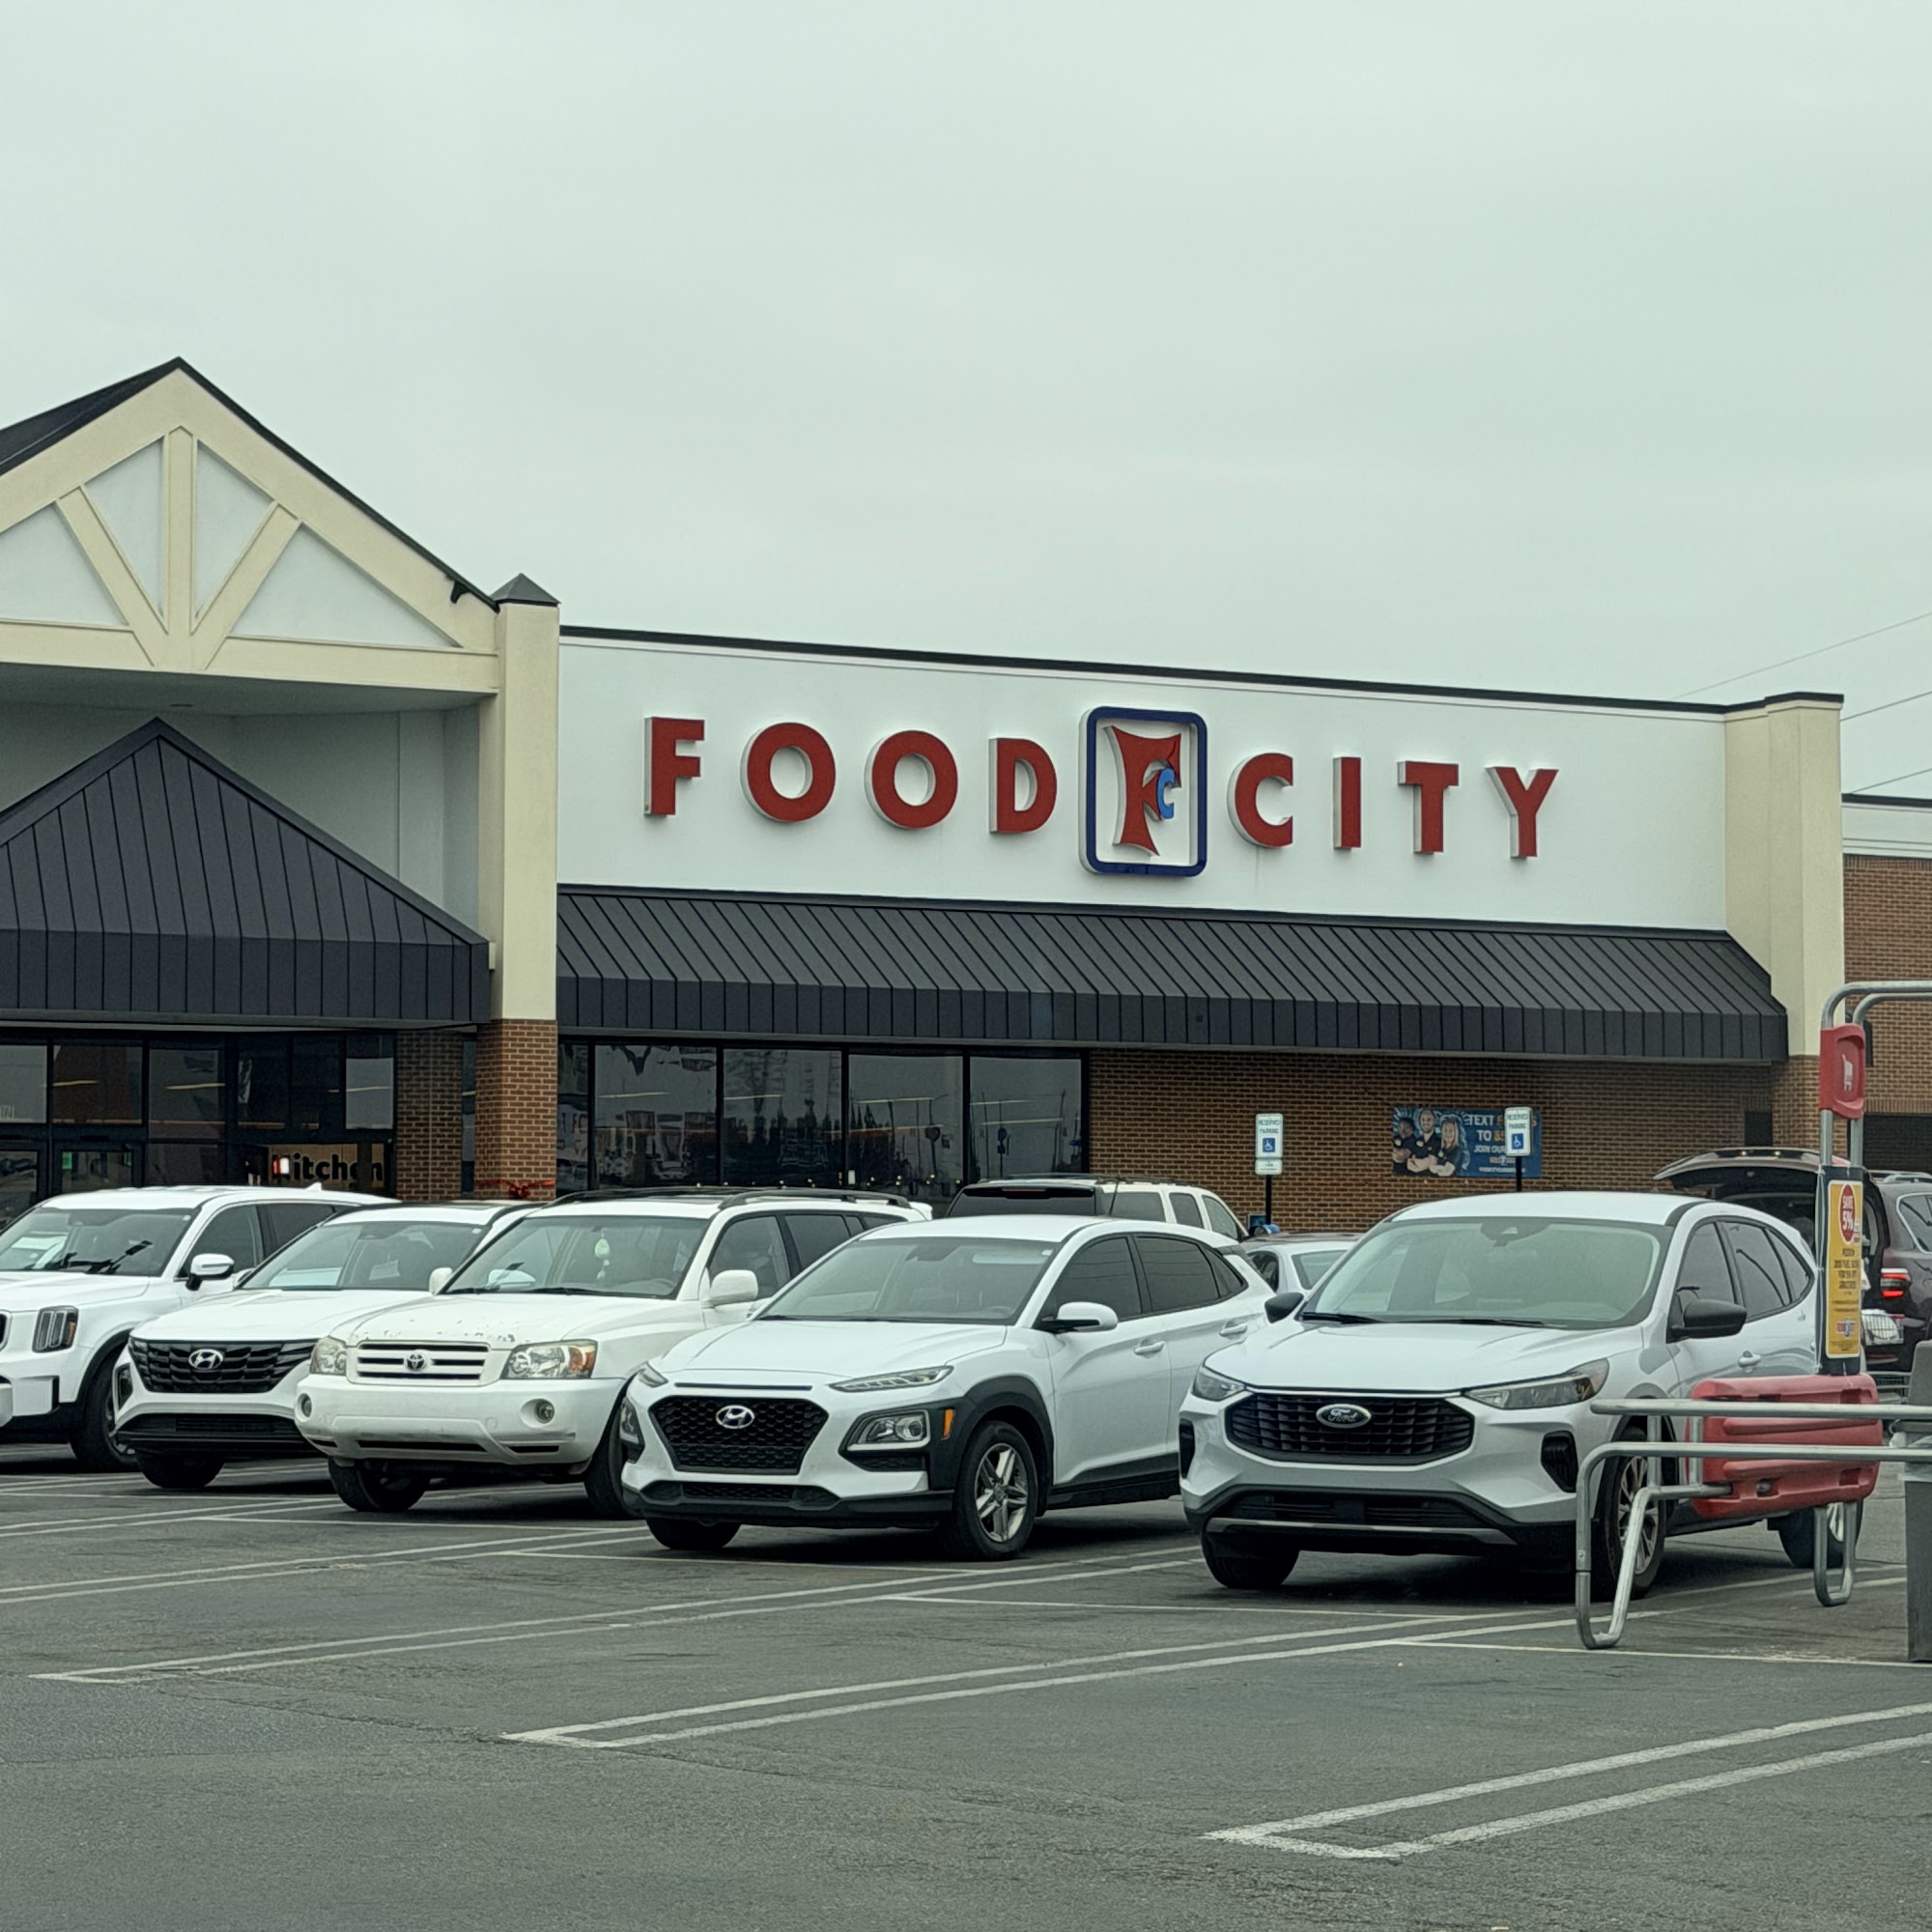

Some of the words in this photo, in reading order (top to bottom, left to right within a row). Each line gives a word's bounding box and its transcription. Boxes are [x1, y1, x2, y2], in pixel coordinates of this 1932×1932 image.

[644, 717, 1058, 834] FOOD
[1227, 753, 1559, 858] CITY
[1469, 1114, 1494, 1126] TEXT
[1477, 1130, 1492, 1142] TO
